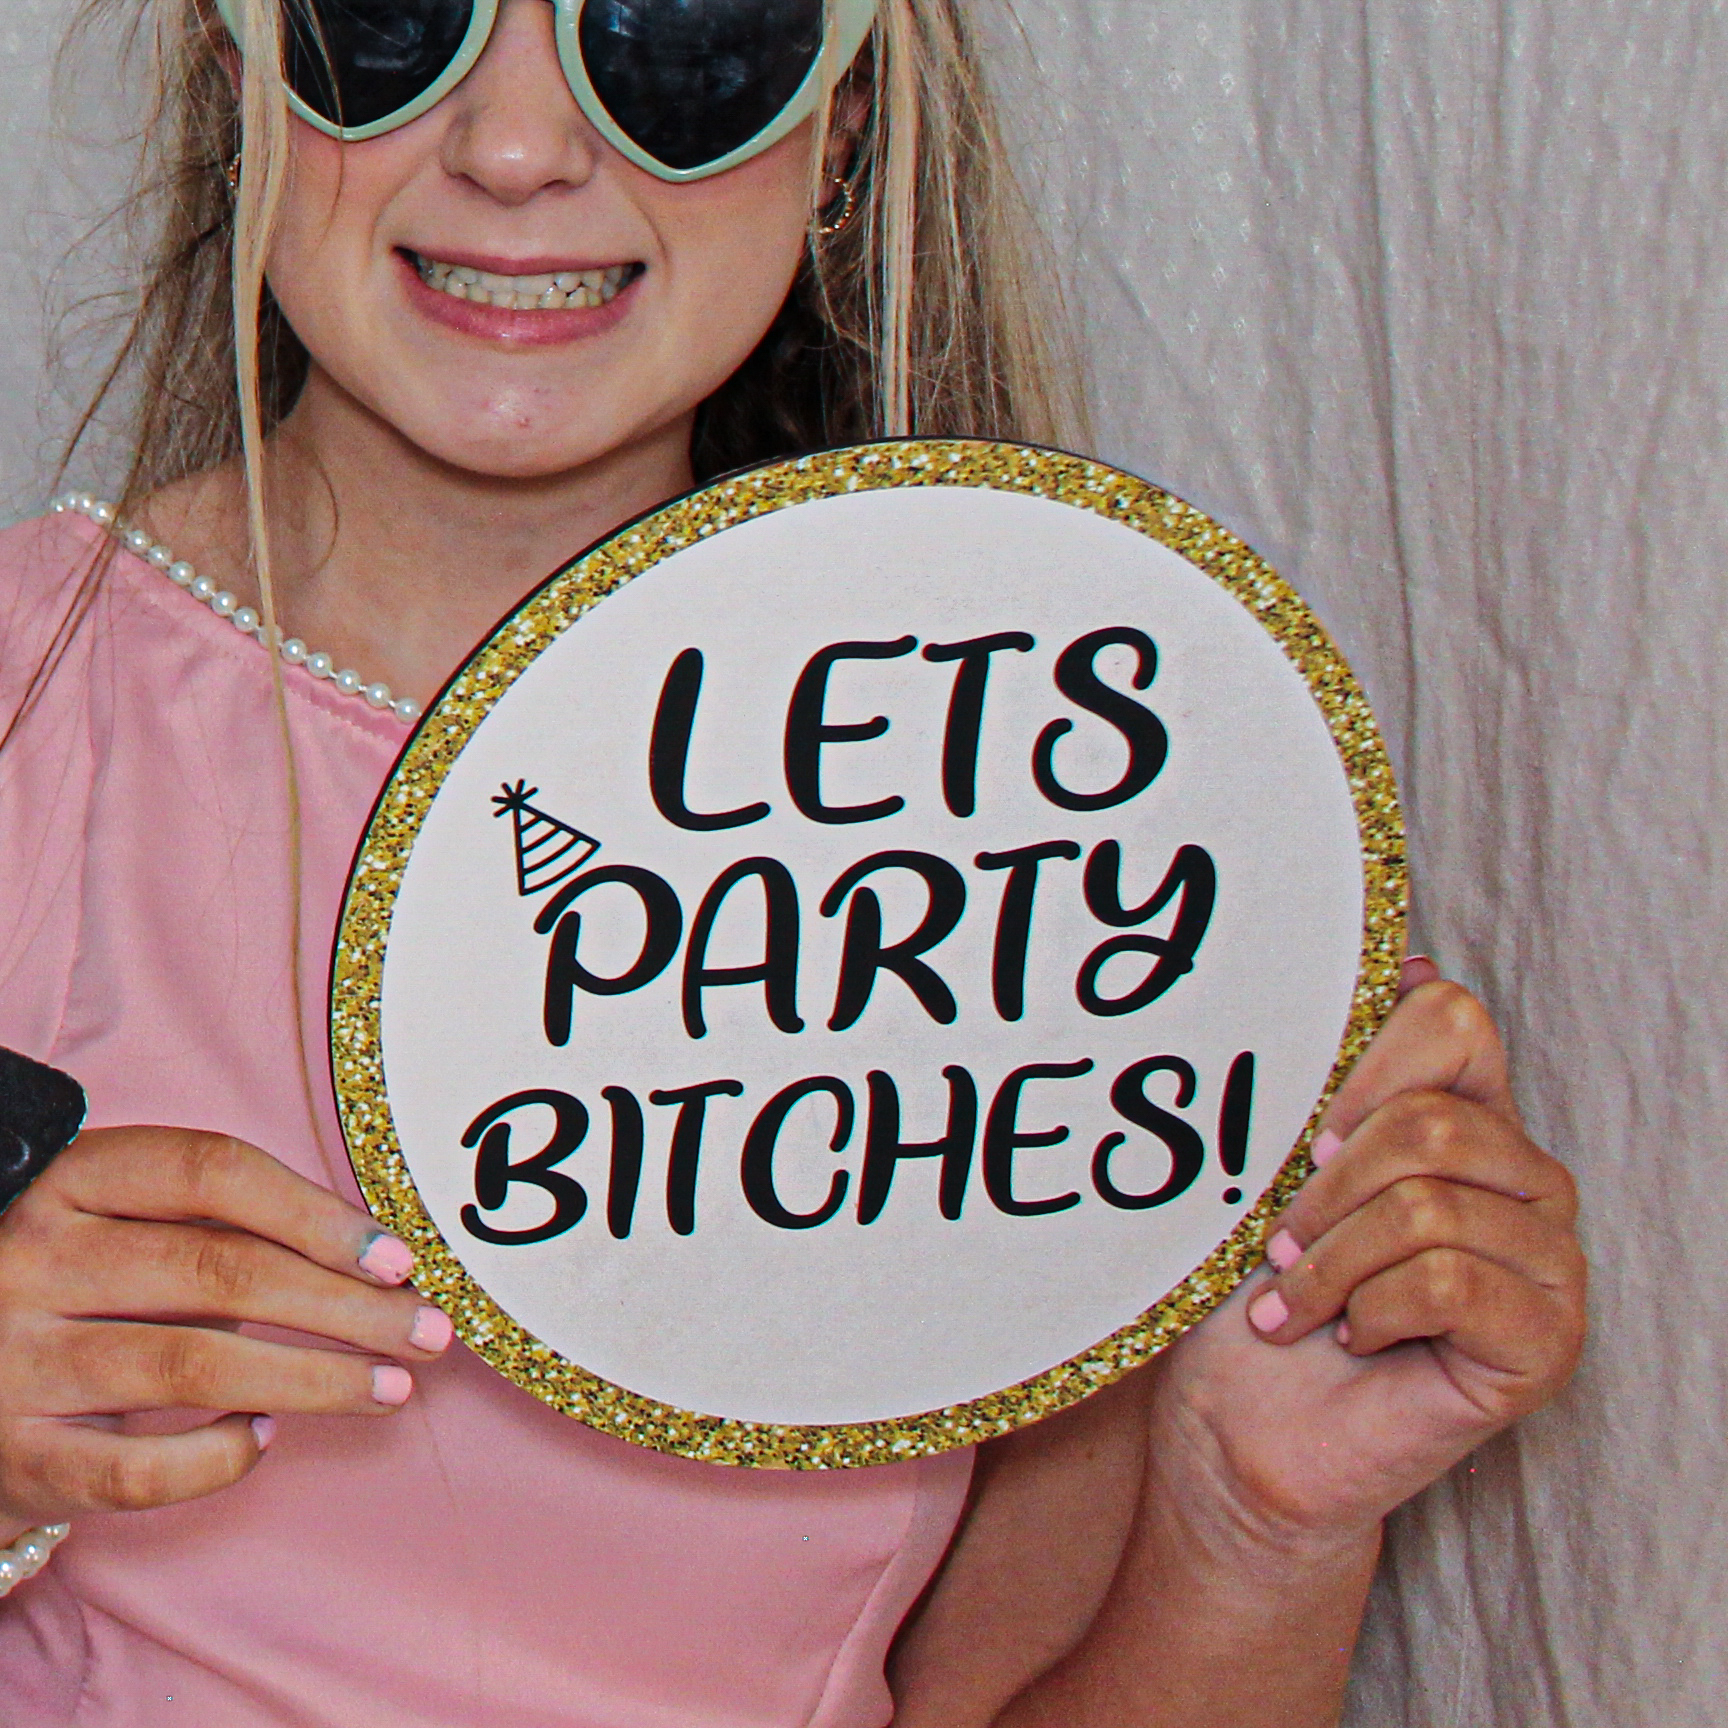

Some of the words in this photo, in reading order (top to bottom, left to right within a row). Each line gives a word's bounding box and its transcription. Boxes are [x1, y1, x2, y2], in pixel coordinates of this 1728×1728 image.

[648, 627, 1170, 833] LETS
[534, 840, 1218, 1047] PARTY
[461, 1052, 1255, 1246] BITCHES!
